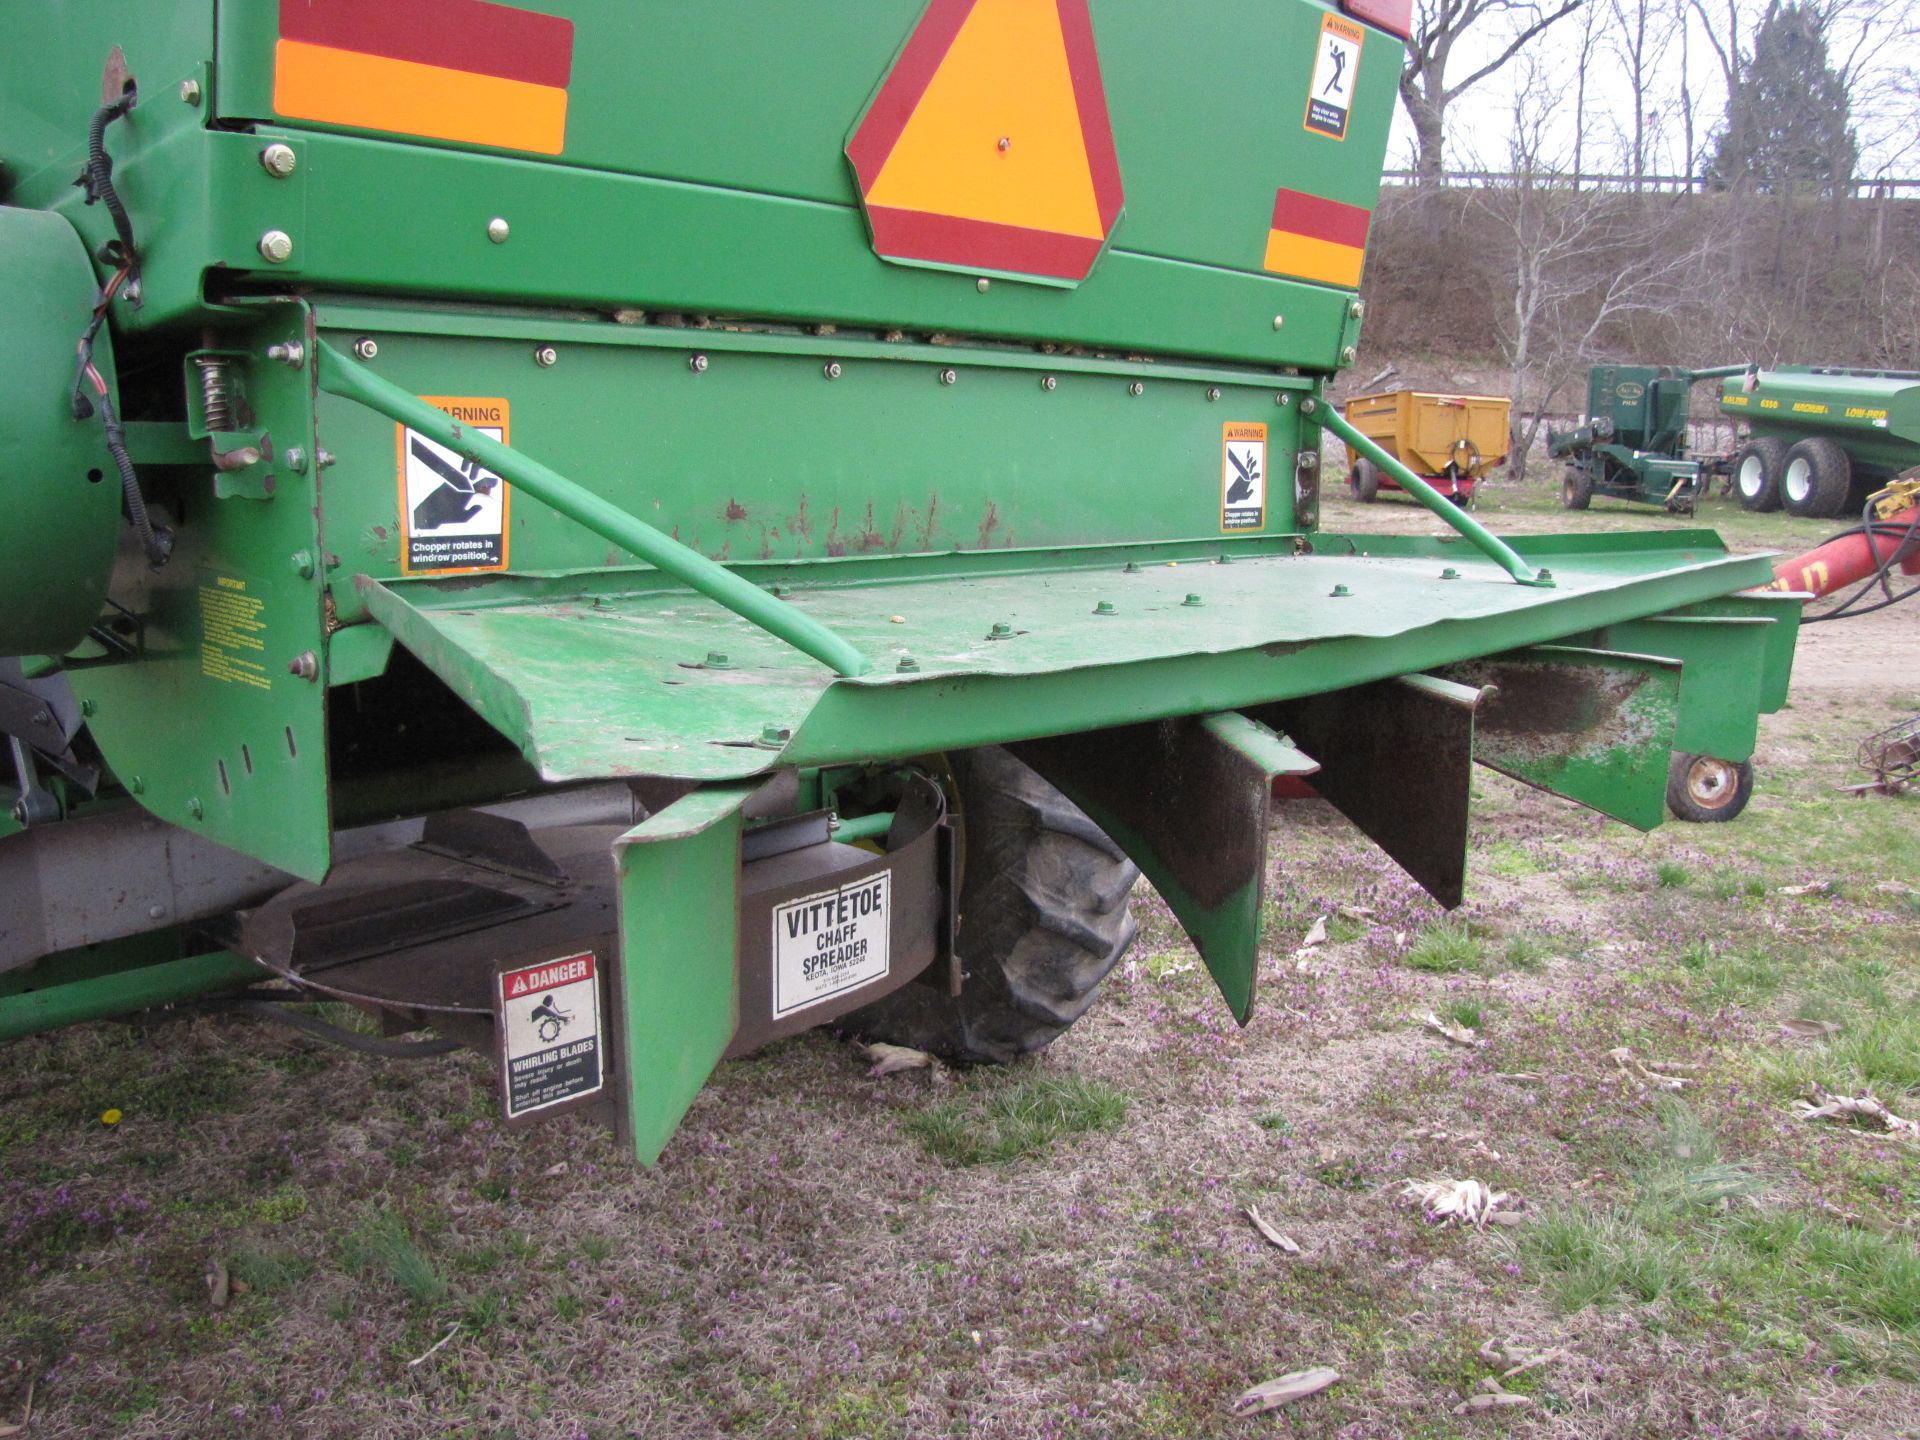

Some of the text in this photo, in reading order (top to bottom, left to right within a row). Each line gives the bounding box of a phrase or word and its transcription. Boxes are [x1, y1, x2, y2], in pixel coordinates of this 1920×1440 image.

[1333, 22, 1360, 40] WARNING
[1845, 407, 1887, 420] LOW-PRO
[1234, 428, 1264, 438] WARNING
[412, 540, 494, 552] Chopper rotates in
[412, 553, 450, 563] windrow
[786, 883, 882, 939] VITTETOE
[816, 922, 857, 951] CHAFF
[803, 938, 868, 976] SPREADER
[528, 960, 588, 989] DANGER
[806, 969, 829, 982] KEOTA,
[830, 962, 847, 973] IOWA
[513, 1039, 594, 1073] WHIRLING BLADES
[514, 1072, 535, 1083] Severe
[565, 1057, 582, 1067] death
[514, 1092, 530, 1102] Shut
[542, 1083, 563, 1094] engine
[565, 1076, 584, 1086] before
[515, 1096, 541, 1109] entering
[542, 1092, 554, 1100] this
